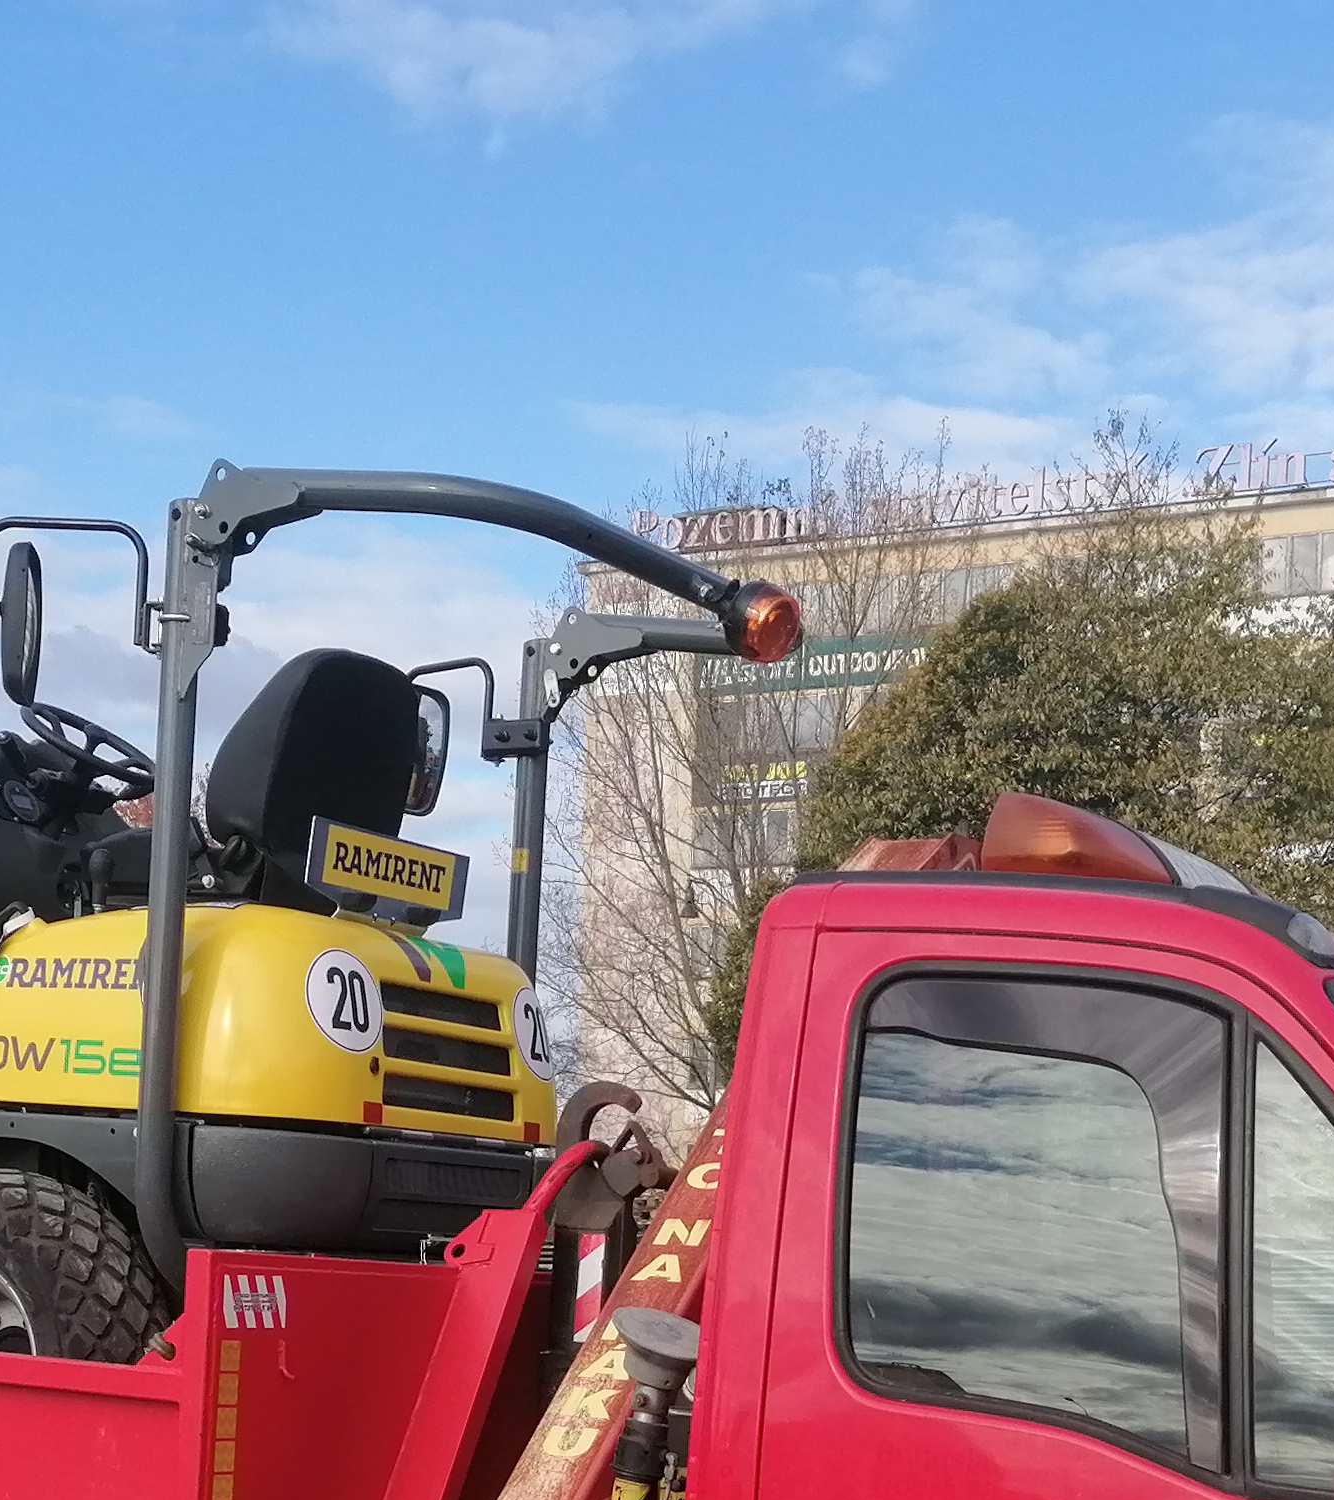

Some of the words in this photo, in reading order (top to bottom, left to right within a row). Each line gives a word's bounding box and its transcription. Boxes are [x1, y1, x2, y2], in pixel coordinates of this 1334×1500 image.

[631, 500, 827, 550] Pozemn
[1196, 438, 1309, 496] Zlín
[333, 841, 446, 893] RAMIRENT
[326, 966, 370, 1034] 20
